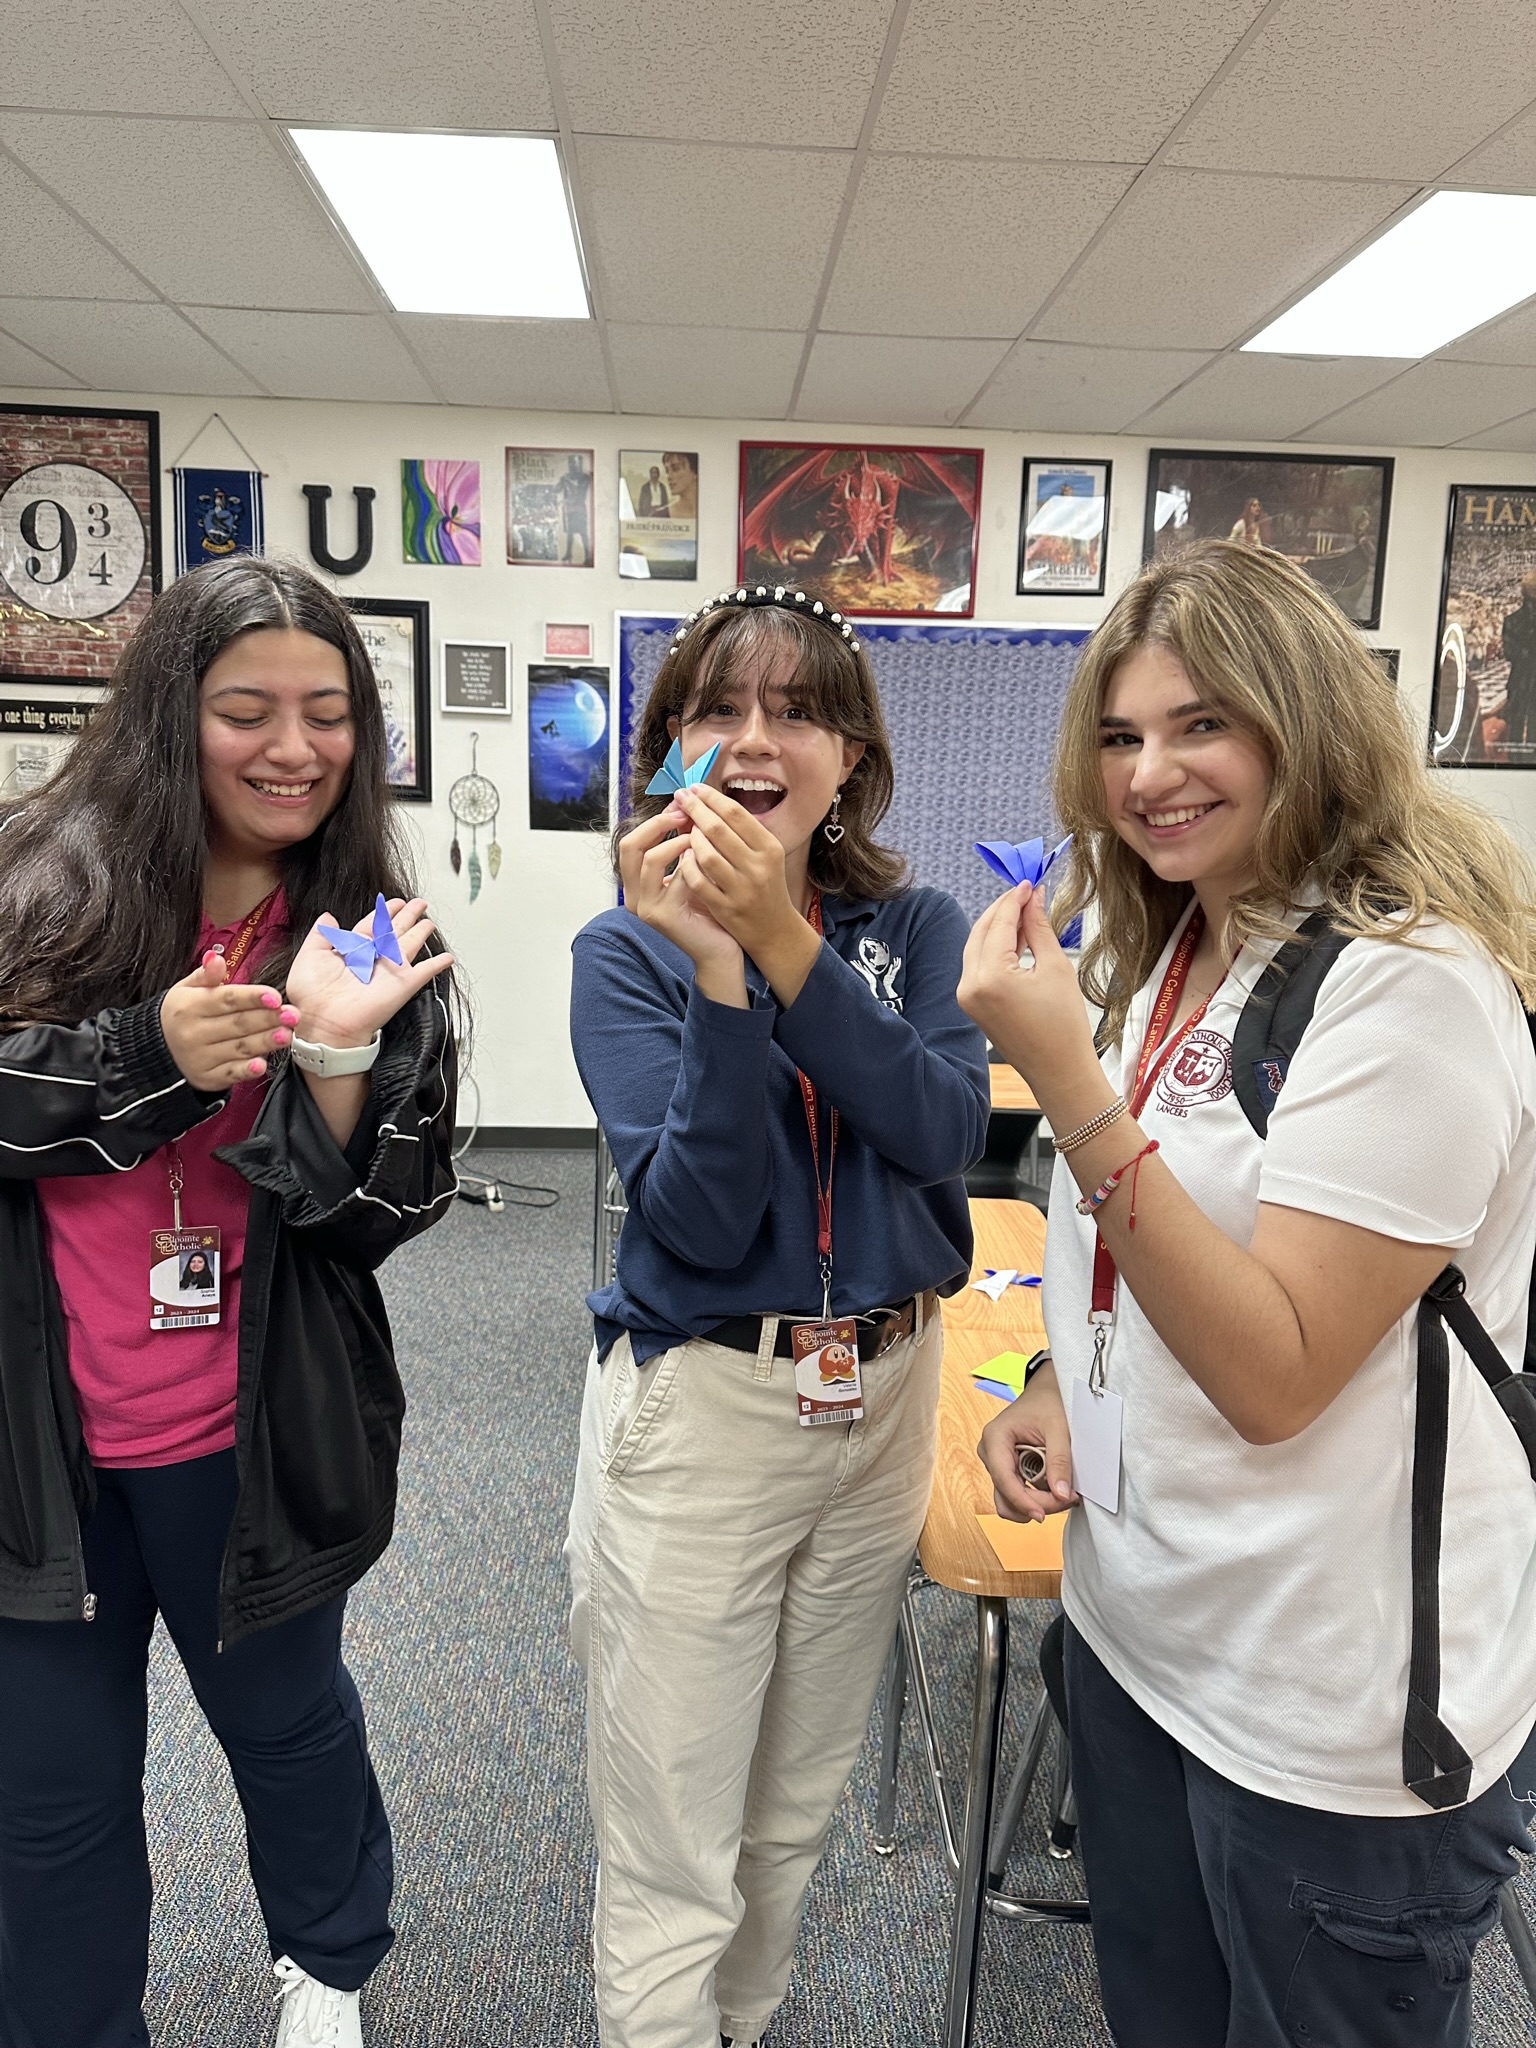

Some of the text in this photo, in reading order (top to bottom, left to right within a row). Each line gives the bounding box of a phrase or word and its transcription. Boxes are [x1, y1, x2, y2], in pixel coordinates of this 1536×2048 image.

[303, 484, 376, 575] U
[4, 711, 21, 723] one
[22, 705, 46, 729] thing
[48, 707, 86, 730] everyday
[226, 926, 253, 967] Salpointe
[1171, 932, 1195, 977] Salpointe
[1155, 979, 1178, 1020] Catholic
[1140, 1022, 1163, 1064] Lancers
[1190, 1031, 1227, 1048] ATHOLIC
[1156, 1102, 1189, 1118] LANCERS
